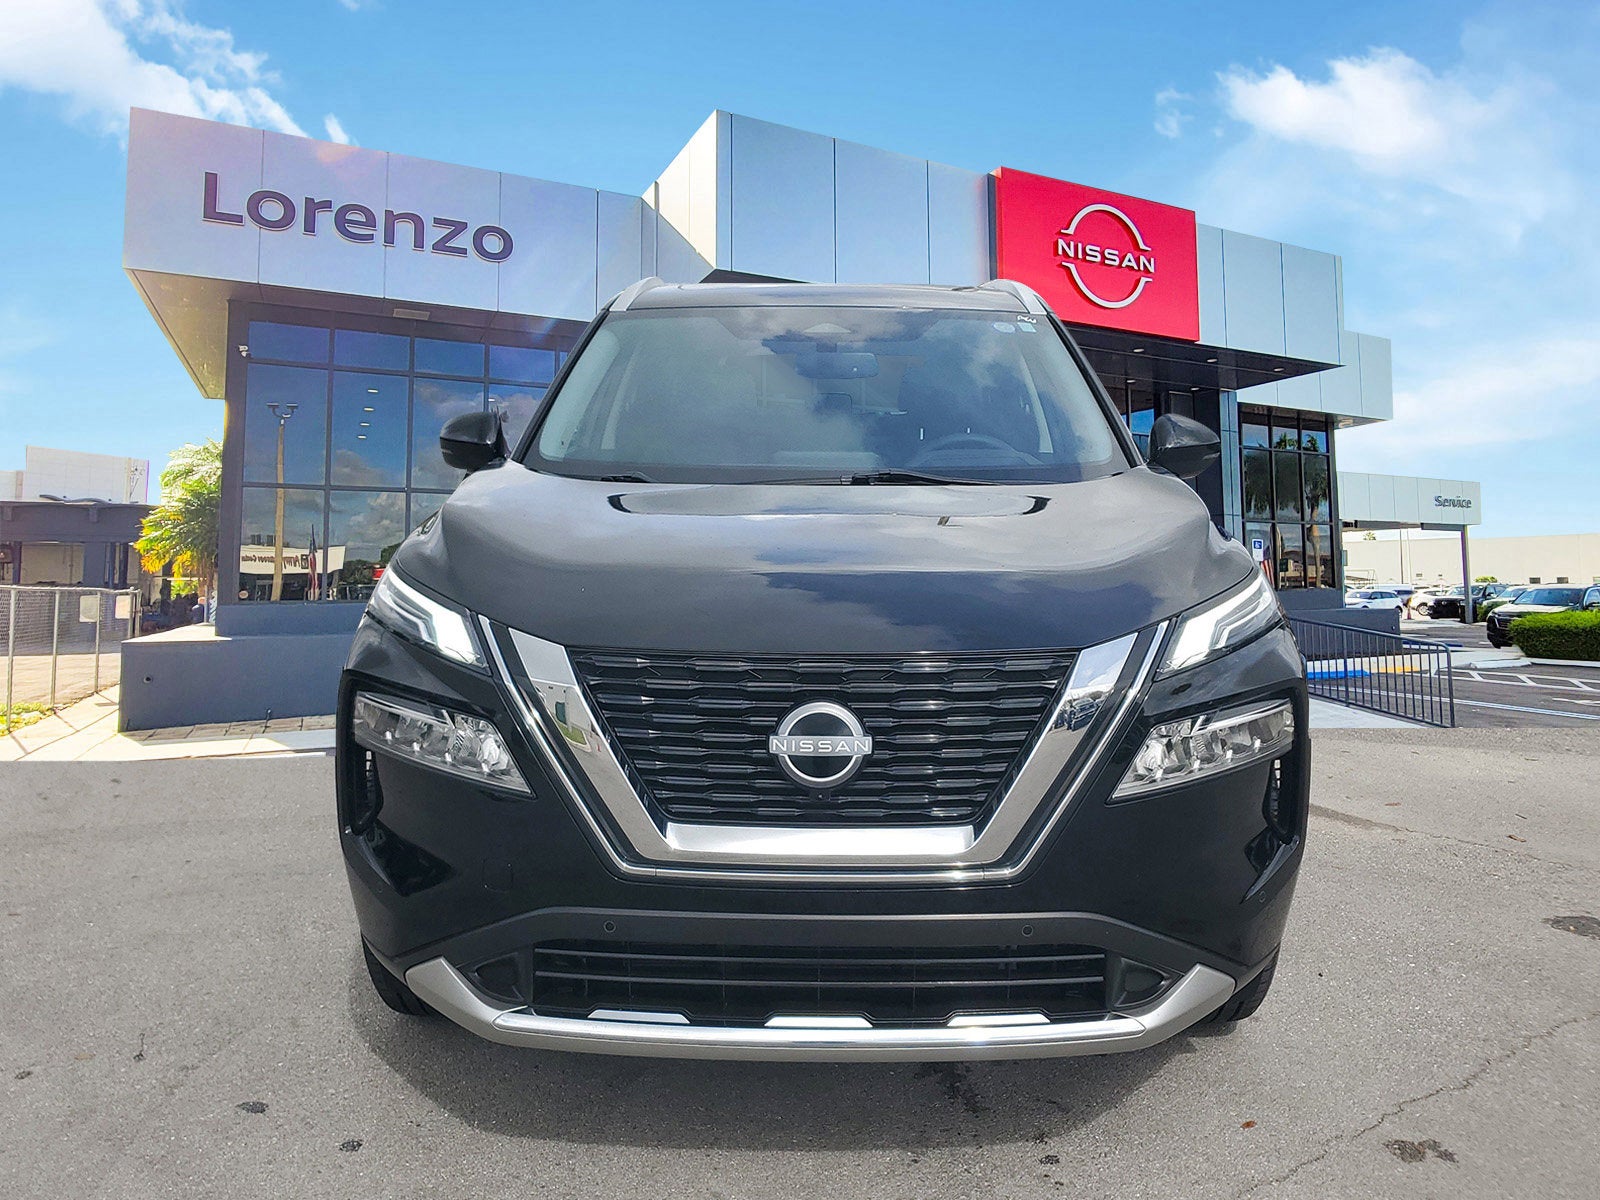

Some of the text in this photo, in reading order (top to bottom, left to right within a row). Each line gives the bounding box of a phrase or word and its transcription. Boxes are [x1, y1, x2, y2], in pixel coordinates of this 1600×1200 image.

[202, 171, 515, 263] Lorenzo
[1056, 238, 1155, 273] NISSAN
[1434, 495, 1472, 509] Service
[772, 738, 869, 753] NISSAN
